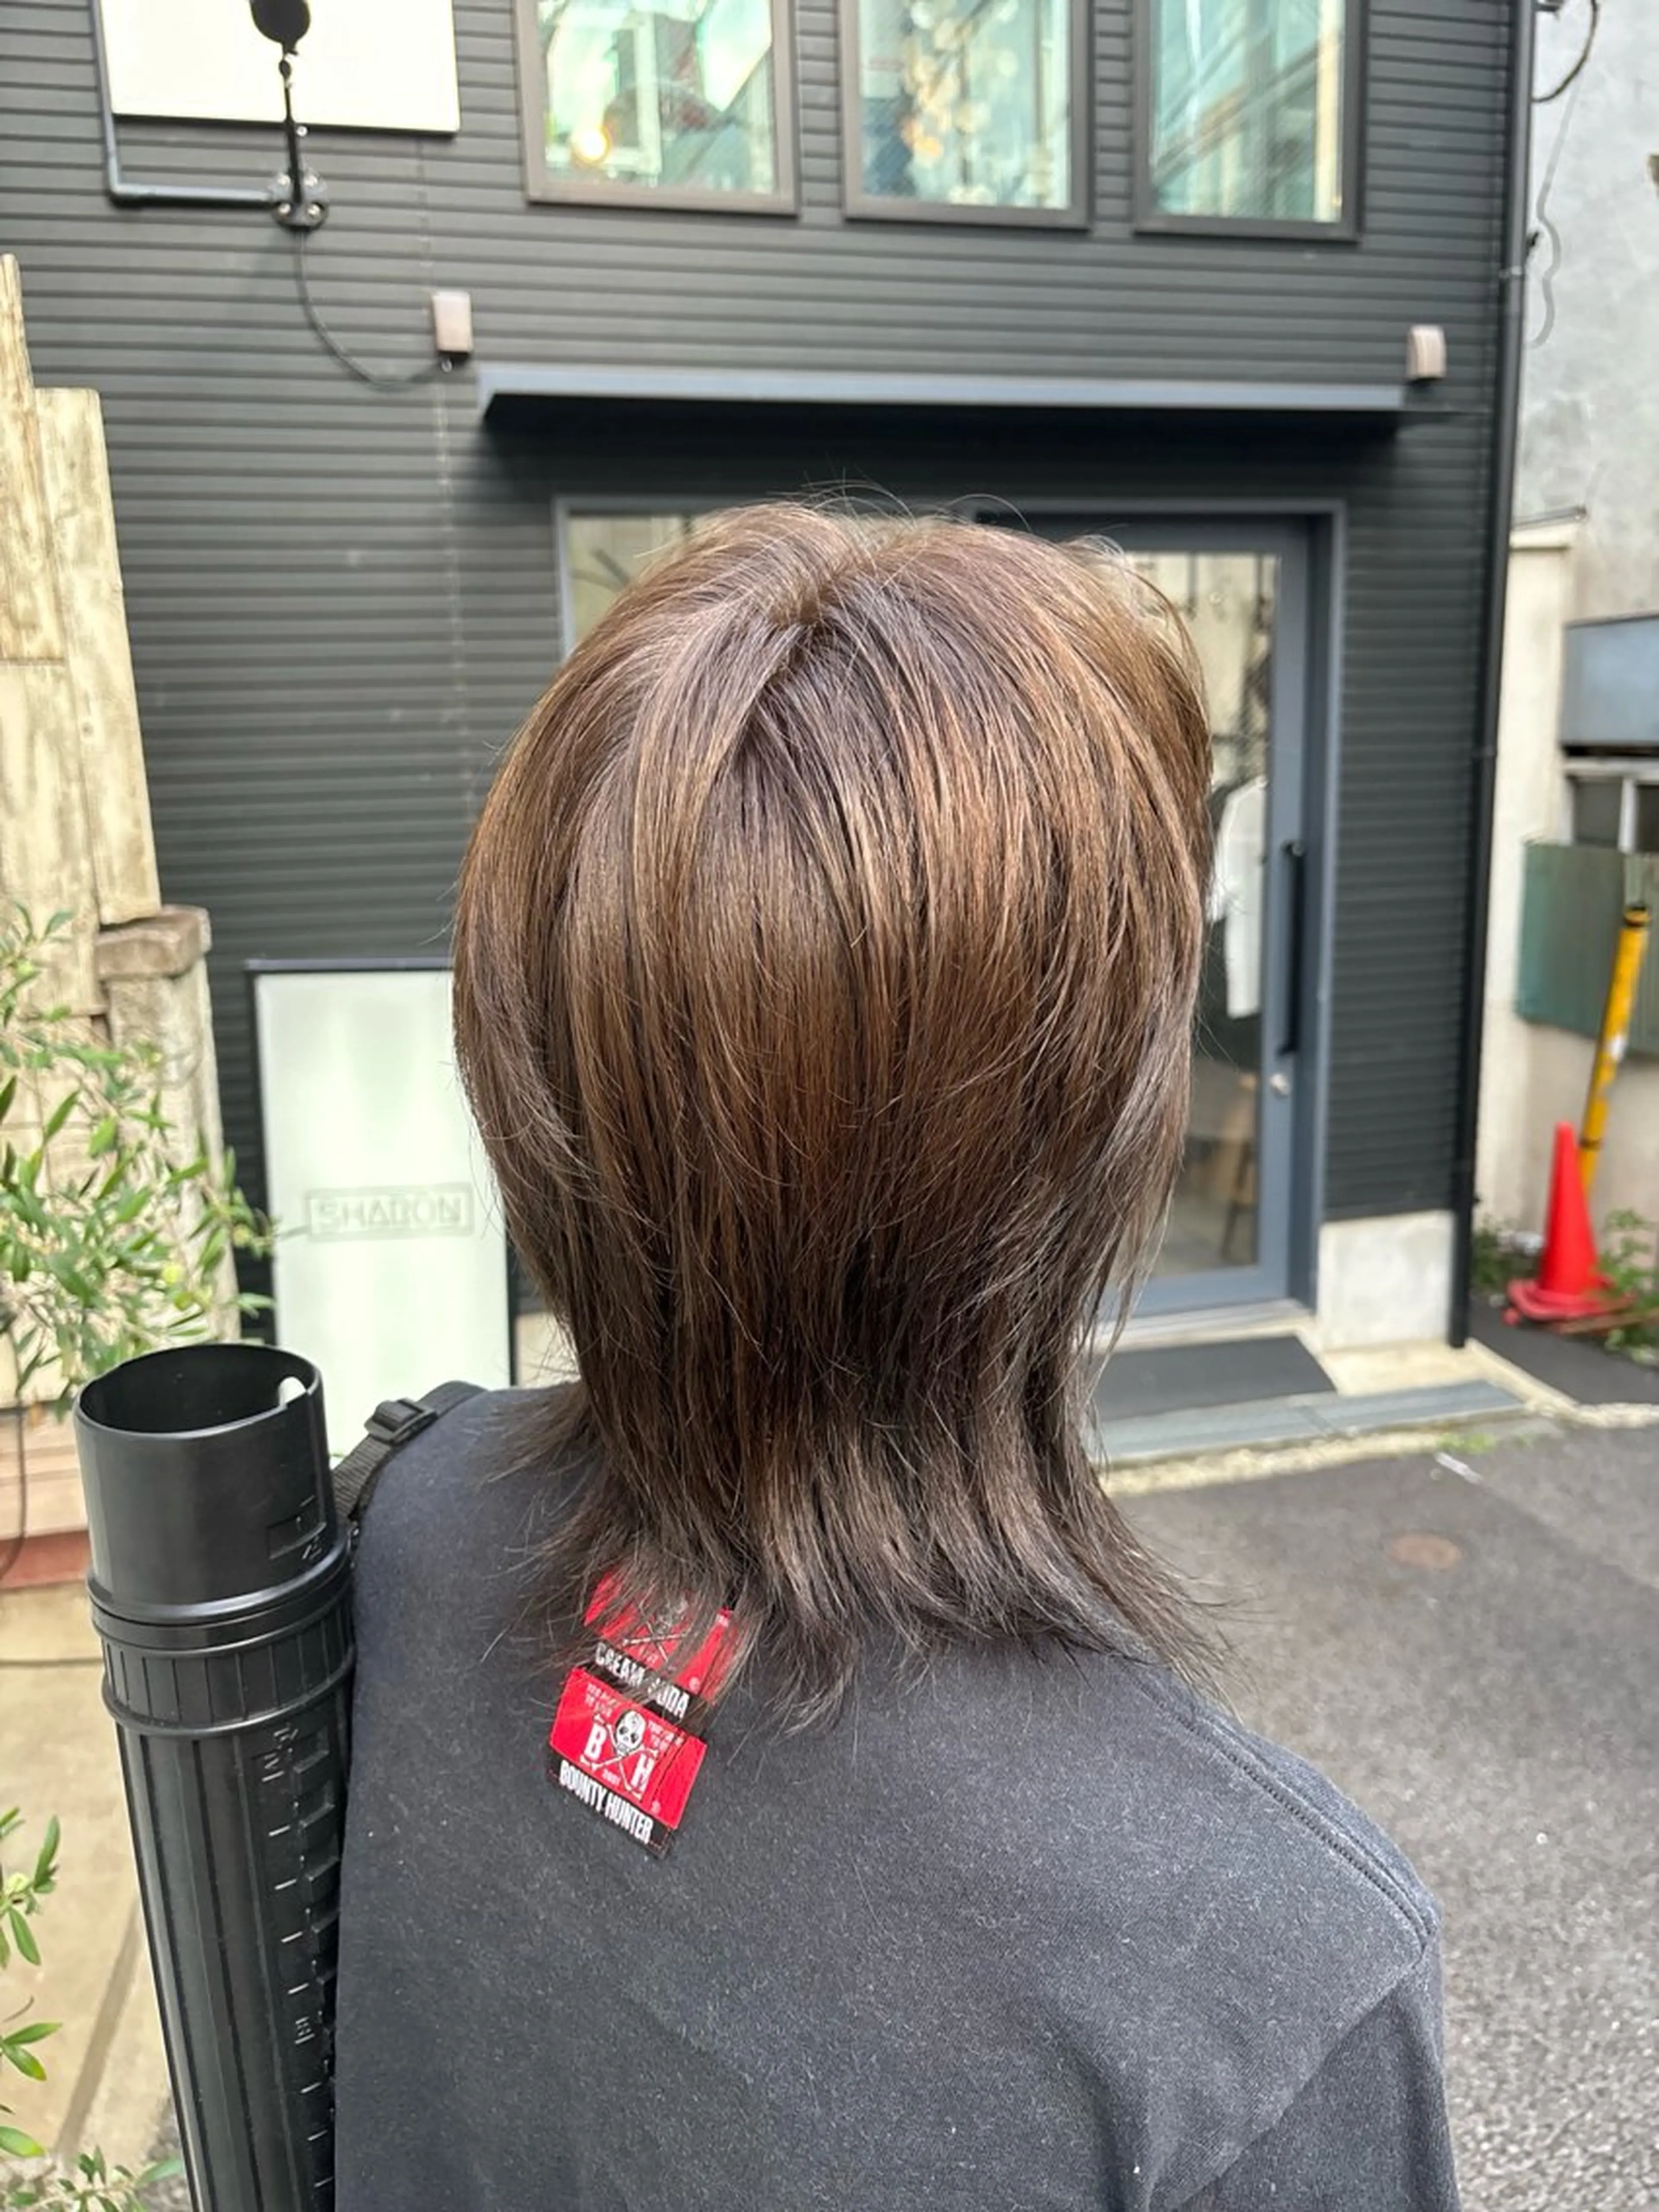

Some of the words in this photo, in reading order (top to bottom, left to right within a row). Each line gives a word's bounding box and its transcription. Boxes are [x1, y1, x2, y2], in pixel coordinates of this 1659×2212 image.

[584, 1723, 607, 1761] B
[631, 1753, 655, 1792] H
[559, 1759, 608, 1812] BOUNTY
[605, 1792, 654, 1844] HUNTER
